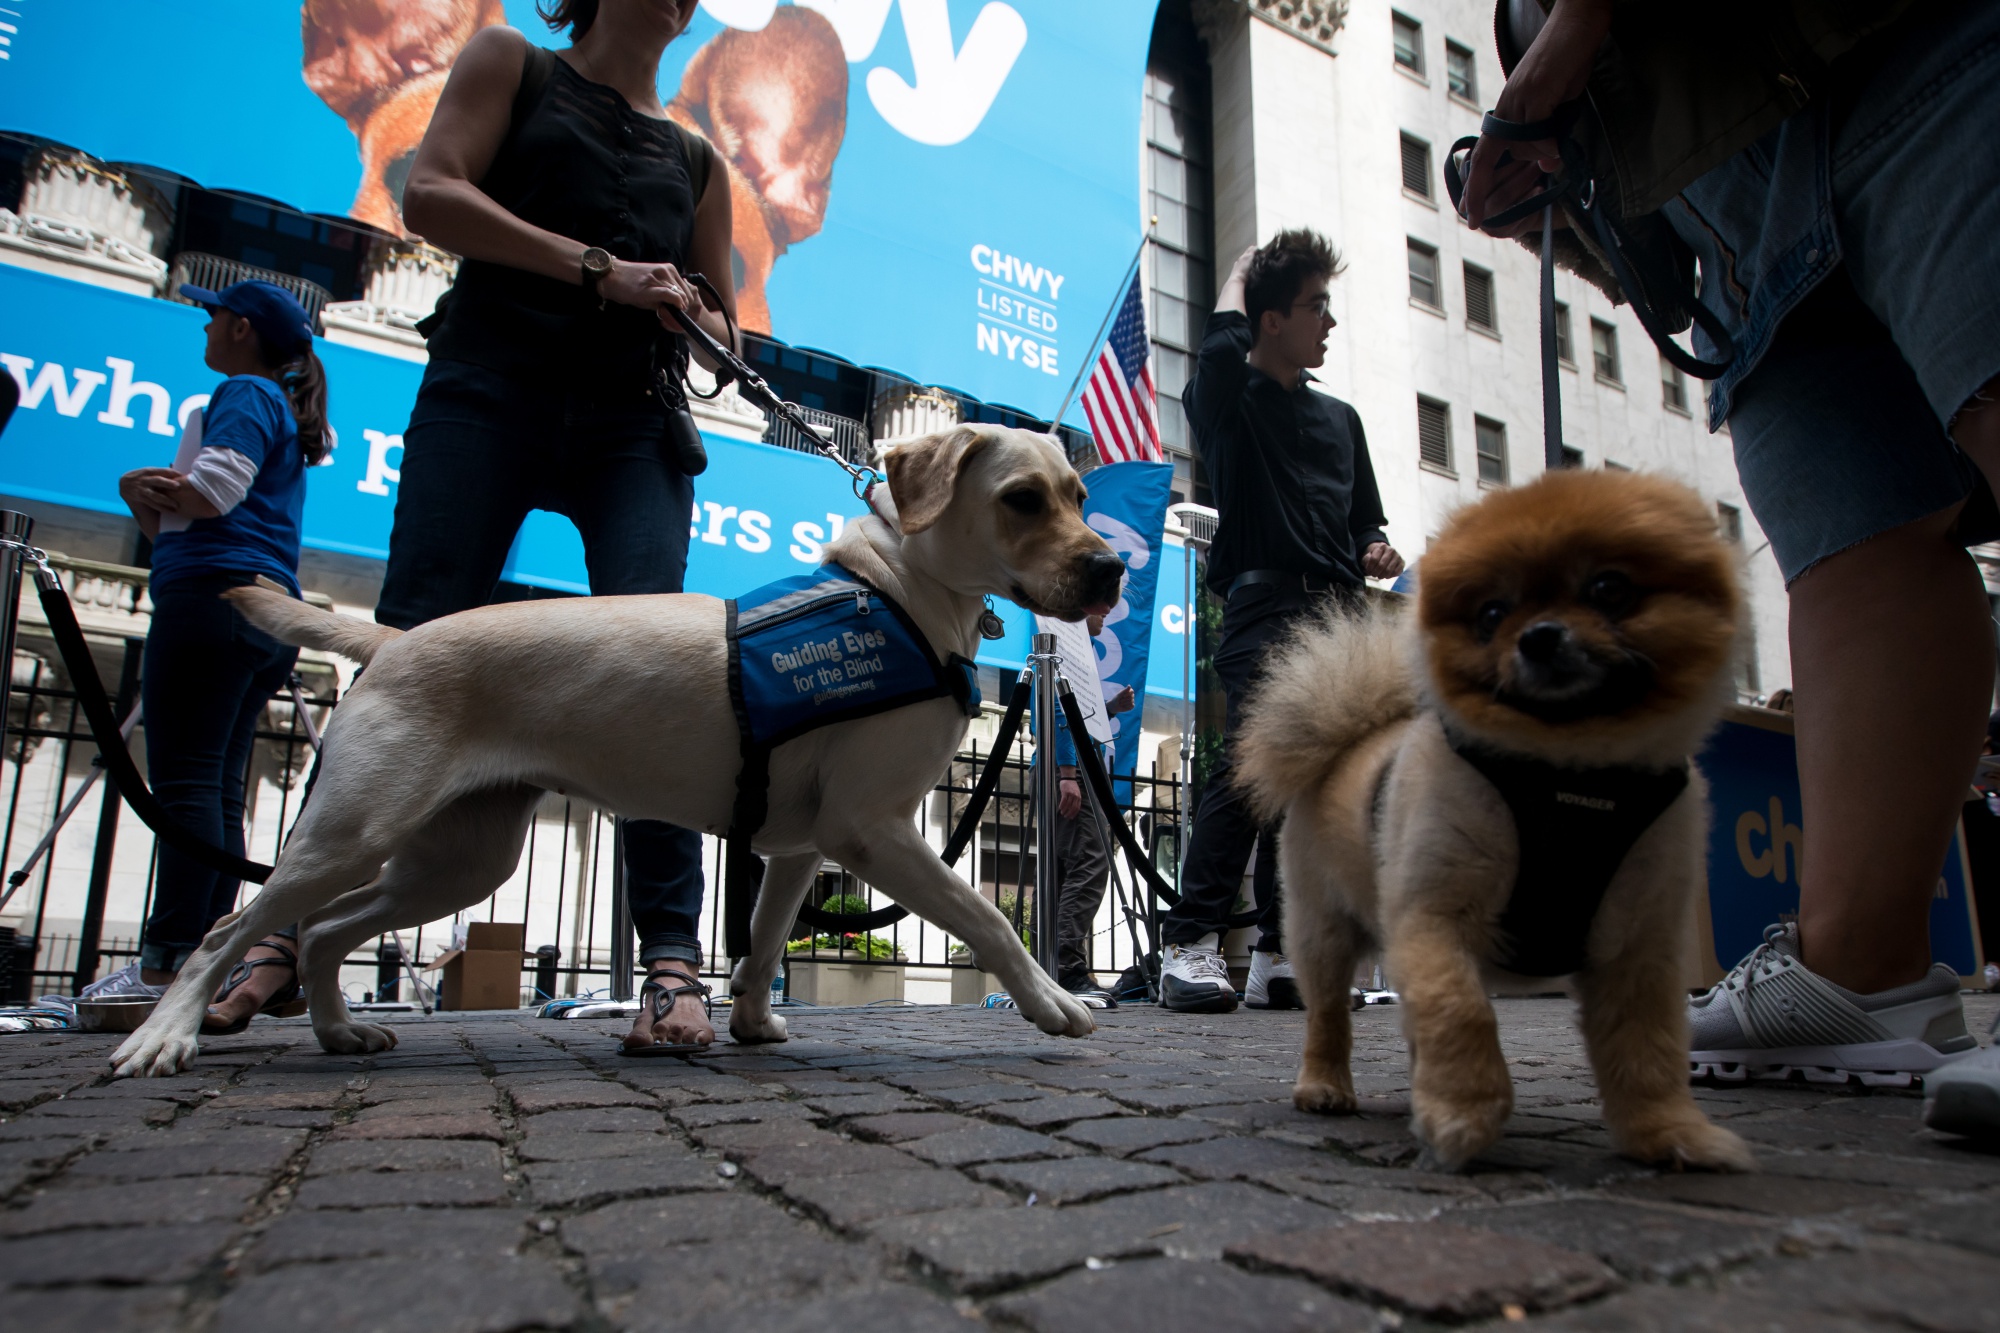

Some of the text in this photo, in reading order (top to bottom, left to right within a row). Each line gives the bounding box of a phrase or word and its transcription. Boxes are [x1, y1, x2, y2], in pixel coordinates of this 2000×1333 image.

[970, 244, 1065, 300] CHWY
[977, 287, 1058, 333] LISTED
[977, 322, 1059, 376] NYSE
[771, 629, 886, 674] Guiding Eyes
[793, 653, 884, 694] for the Blind
[813, 678, 876, 706] guidingeyes.org
[1555, 790, 1616, 812] VOYAGER
